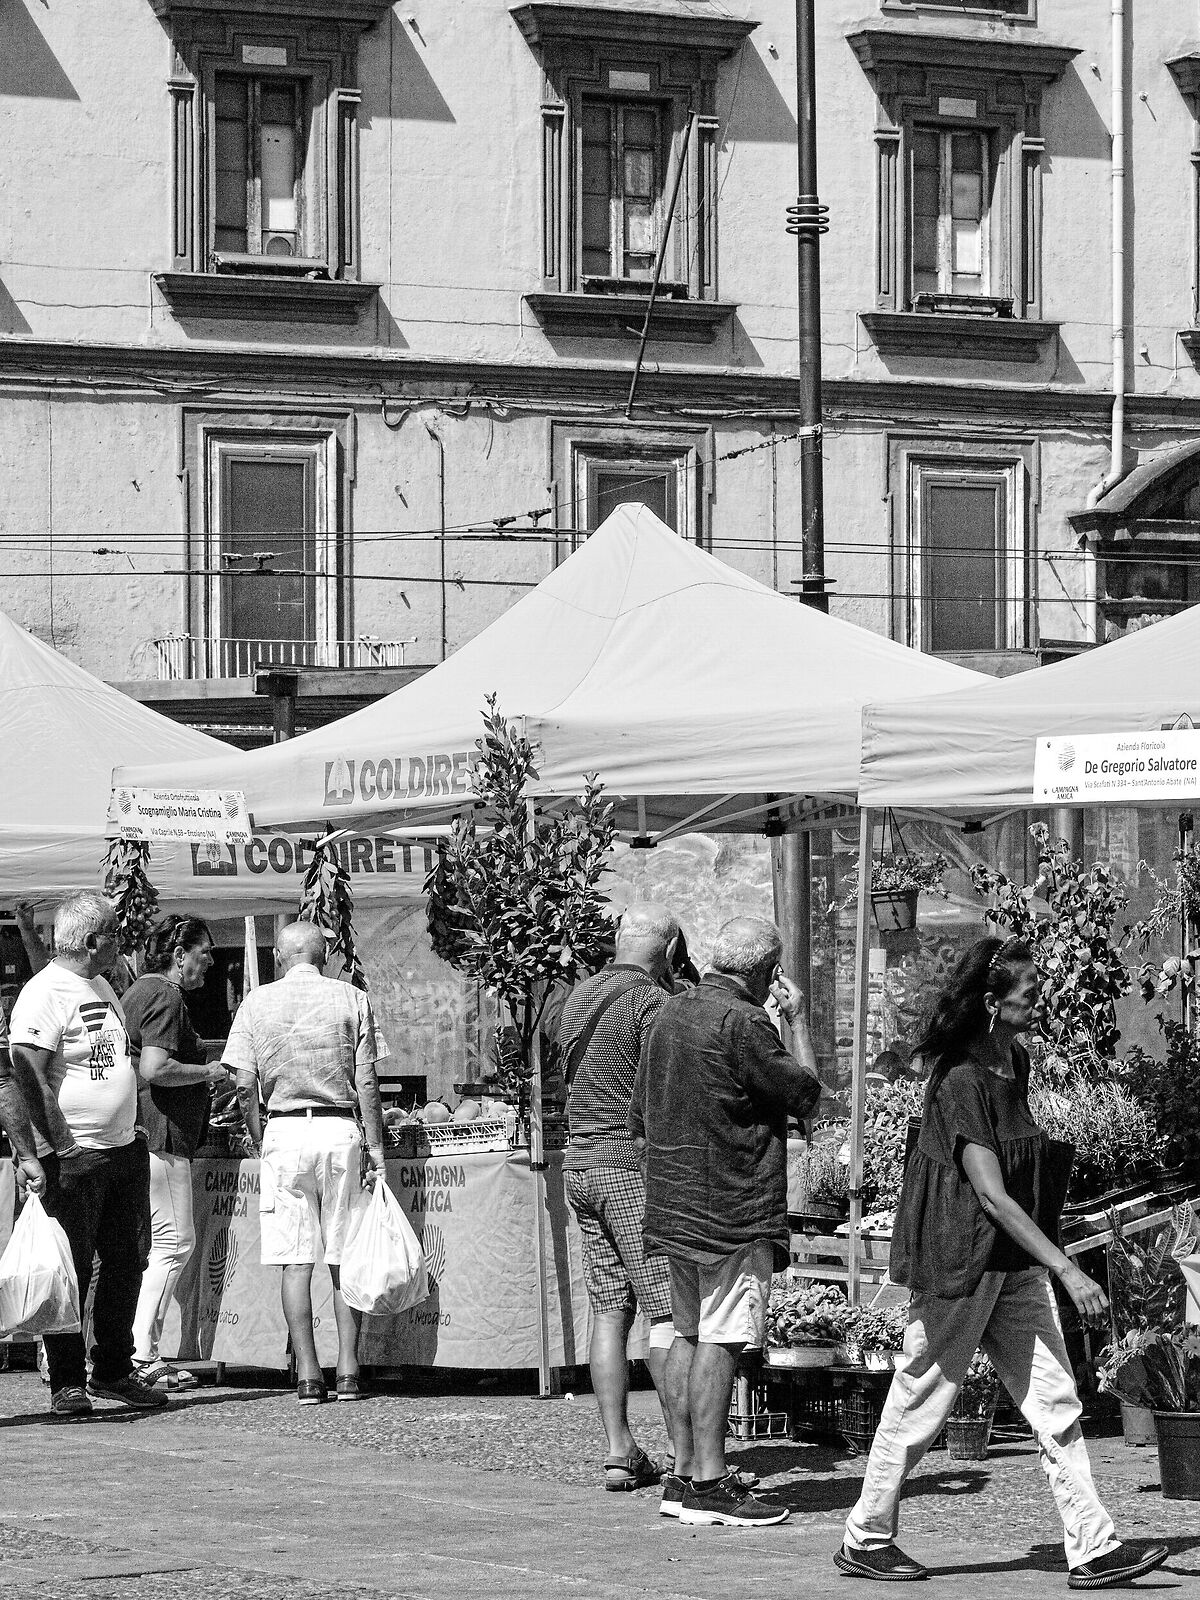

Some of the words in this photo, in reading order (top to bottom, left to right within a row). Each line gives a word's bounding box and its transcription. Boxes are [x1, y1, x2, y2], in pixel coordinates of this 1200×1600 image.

[1116, 741, 1140, 751] Azienda
[1084, 760, 1098, 774] De
[1101, 758, 1145, 776] Gregorio
[1147, 756, 1197, 772] Salvatore
[137, 804, 178, 819] Scognamiglio
[178, 806, 197, 818] Maria
[197, 807, 222, 819] Cristina
[90, 1043, 117, 1058] YACHT
[89, 1055, 115, 1069] CLUB
[205, 1170, 261, 1195] CAMPAGNA
[400, 1165, 466, 1188] CAMPAGNA
[211, 1195, 249, 1218] AMICA
[411, 1190, 453, 1213] AMICA
